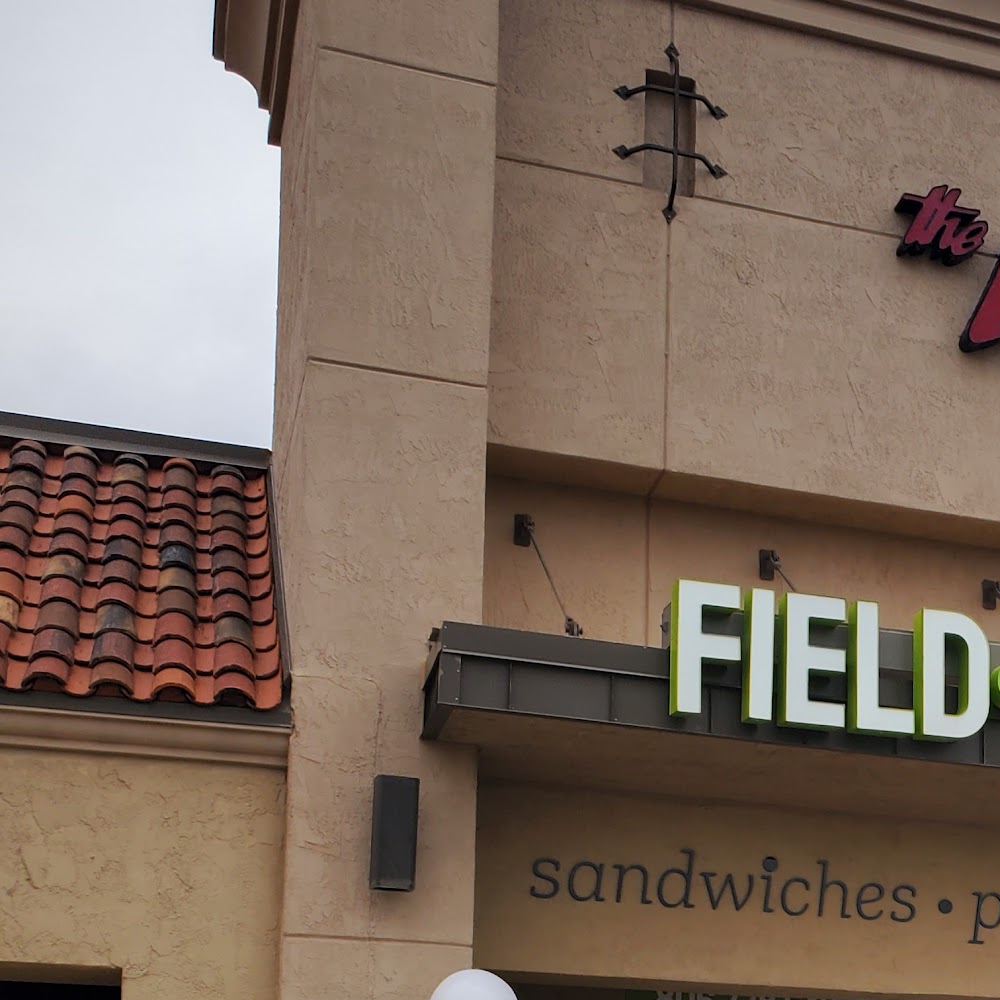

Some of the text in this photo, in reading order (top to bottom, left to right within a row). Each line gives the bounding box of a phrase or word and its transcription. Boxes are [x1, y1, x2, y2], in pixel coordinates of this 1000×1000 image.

[894, 184, 988, 267] the
[669, 577, 991, 743] FIELD
[529, 848, 917, 924] sandwiches
